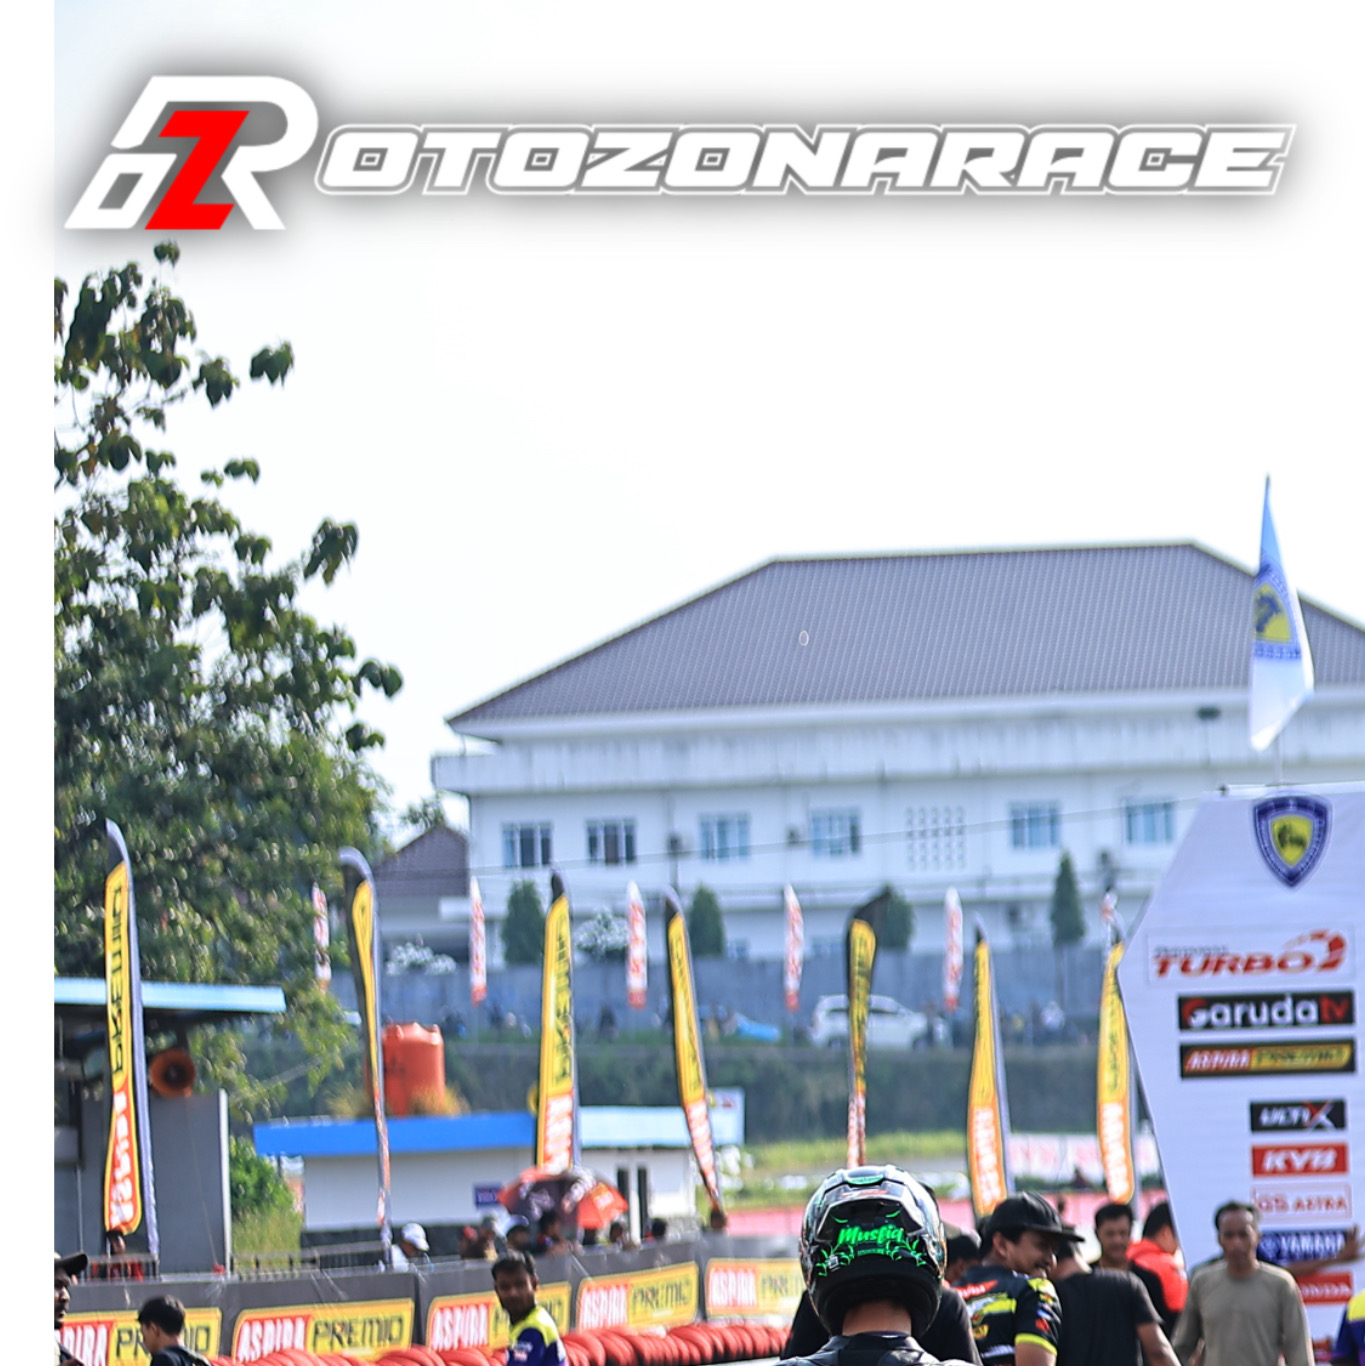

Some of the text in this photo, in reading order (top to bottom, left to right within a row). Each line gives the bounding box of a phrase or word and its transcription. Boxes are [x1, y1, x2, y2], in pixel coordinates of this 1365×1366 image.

[1153, 953, 1314, 978] TURBO
[579, 1284, 628, 1329] ASPIRA
[708, 1267, 757, 1307] ASPIRA
[237, 1313, 403, 1363] ASPIRA PREMIO
[431, 1303, 489, 1351] ASPIRA
